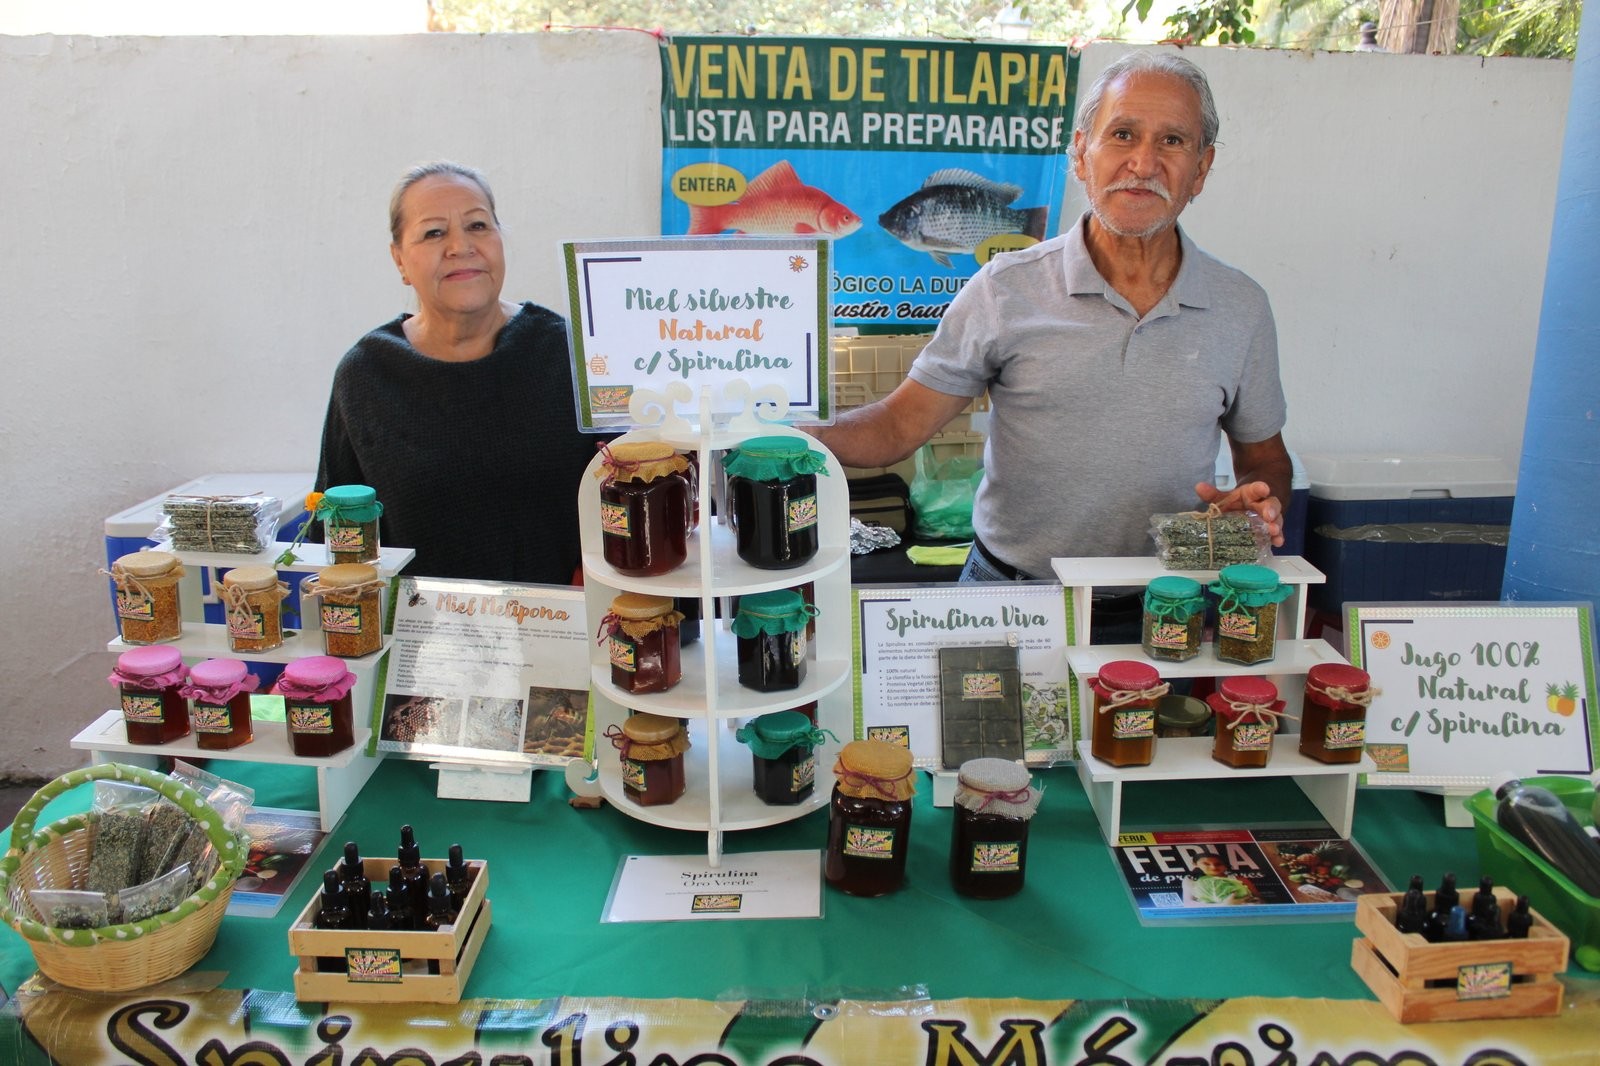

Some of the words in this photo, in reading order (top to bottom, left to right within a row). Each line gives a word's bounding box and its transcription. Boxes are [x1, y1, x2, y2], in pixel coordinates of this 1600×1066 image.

[667, 44, 812, 101] VENTA
[828, 46, 886, 102] DE
[901, 49, 1067, 107] TILAPIA
[668, 109, 756, 143] LISTA
[768, 110, 848, 145] PARA
[863, 112, 1064, 149] PREPARARSE
[679, 176, 736, 192] ENTERA
[626, 287, 679, 312] Miel
[684, 286, 793, 312] silvestre
[901, 278, 924, 293] LA
[660, 318, 764, 341] Natural
[634, 351, 661, 375] c/
[667, 349, 792, 379] Spirulina
[436, 593, 476, 616] Miel
[480, 595, 570, 624] Melipona
[886, 608, 998, 637] Spirulina
[1002, 605, 1048, 628] Viva
[1400, 642, 1461, 677] Jugo
[1471, 642, 1540, 667] 100%
[1418, 676, 1530, 704] Natural
[1391, 710, 1420, 737] c/
[1426, 708, 1565, 743] Spirulina
[681, 870, 758, 880] Spirulina
[1140, 873, 1160, 882] de
